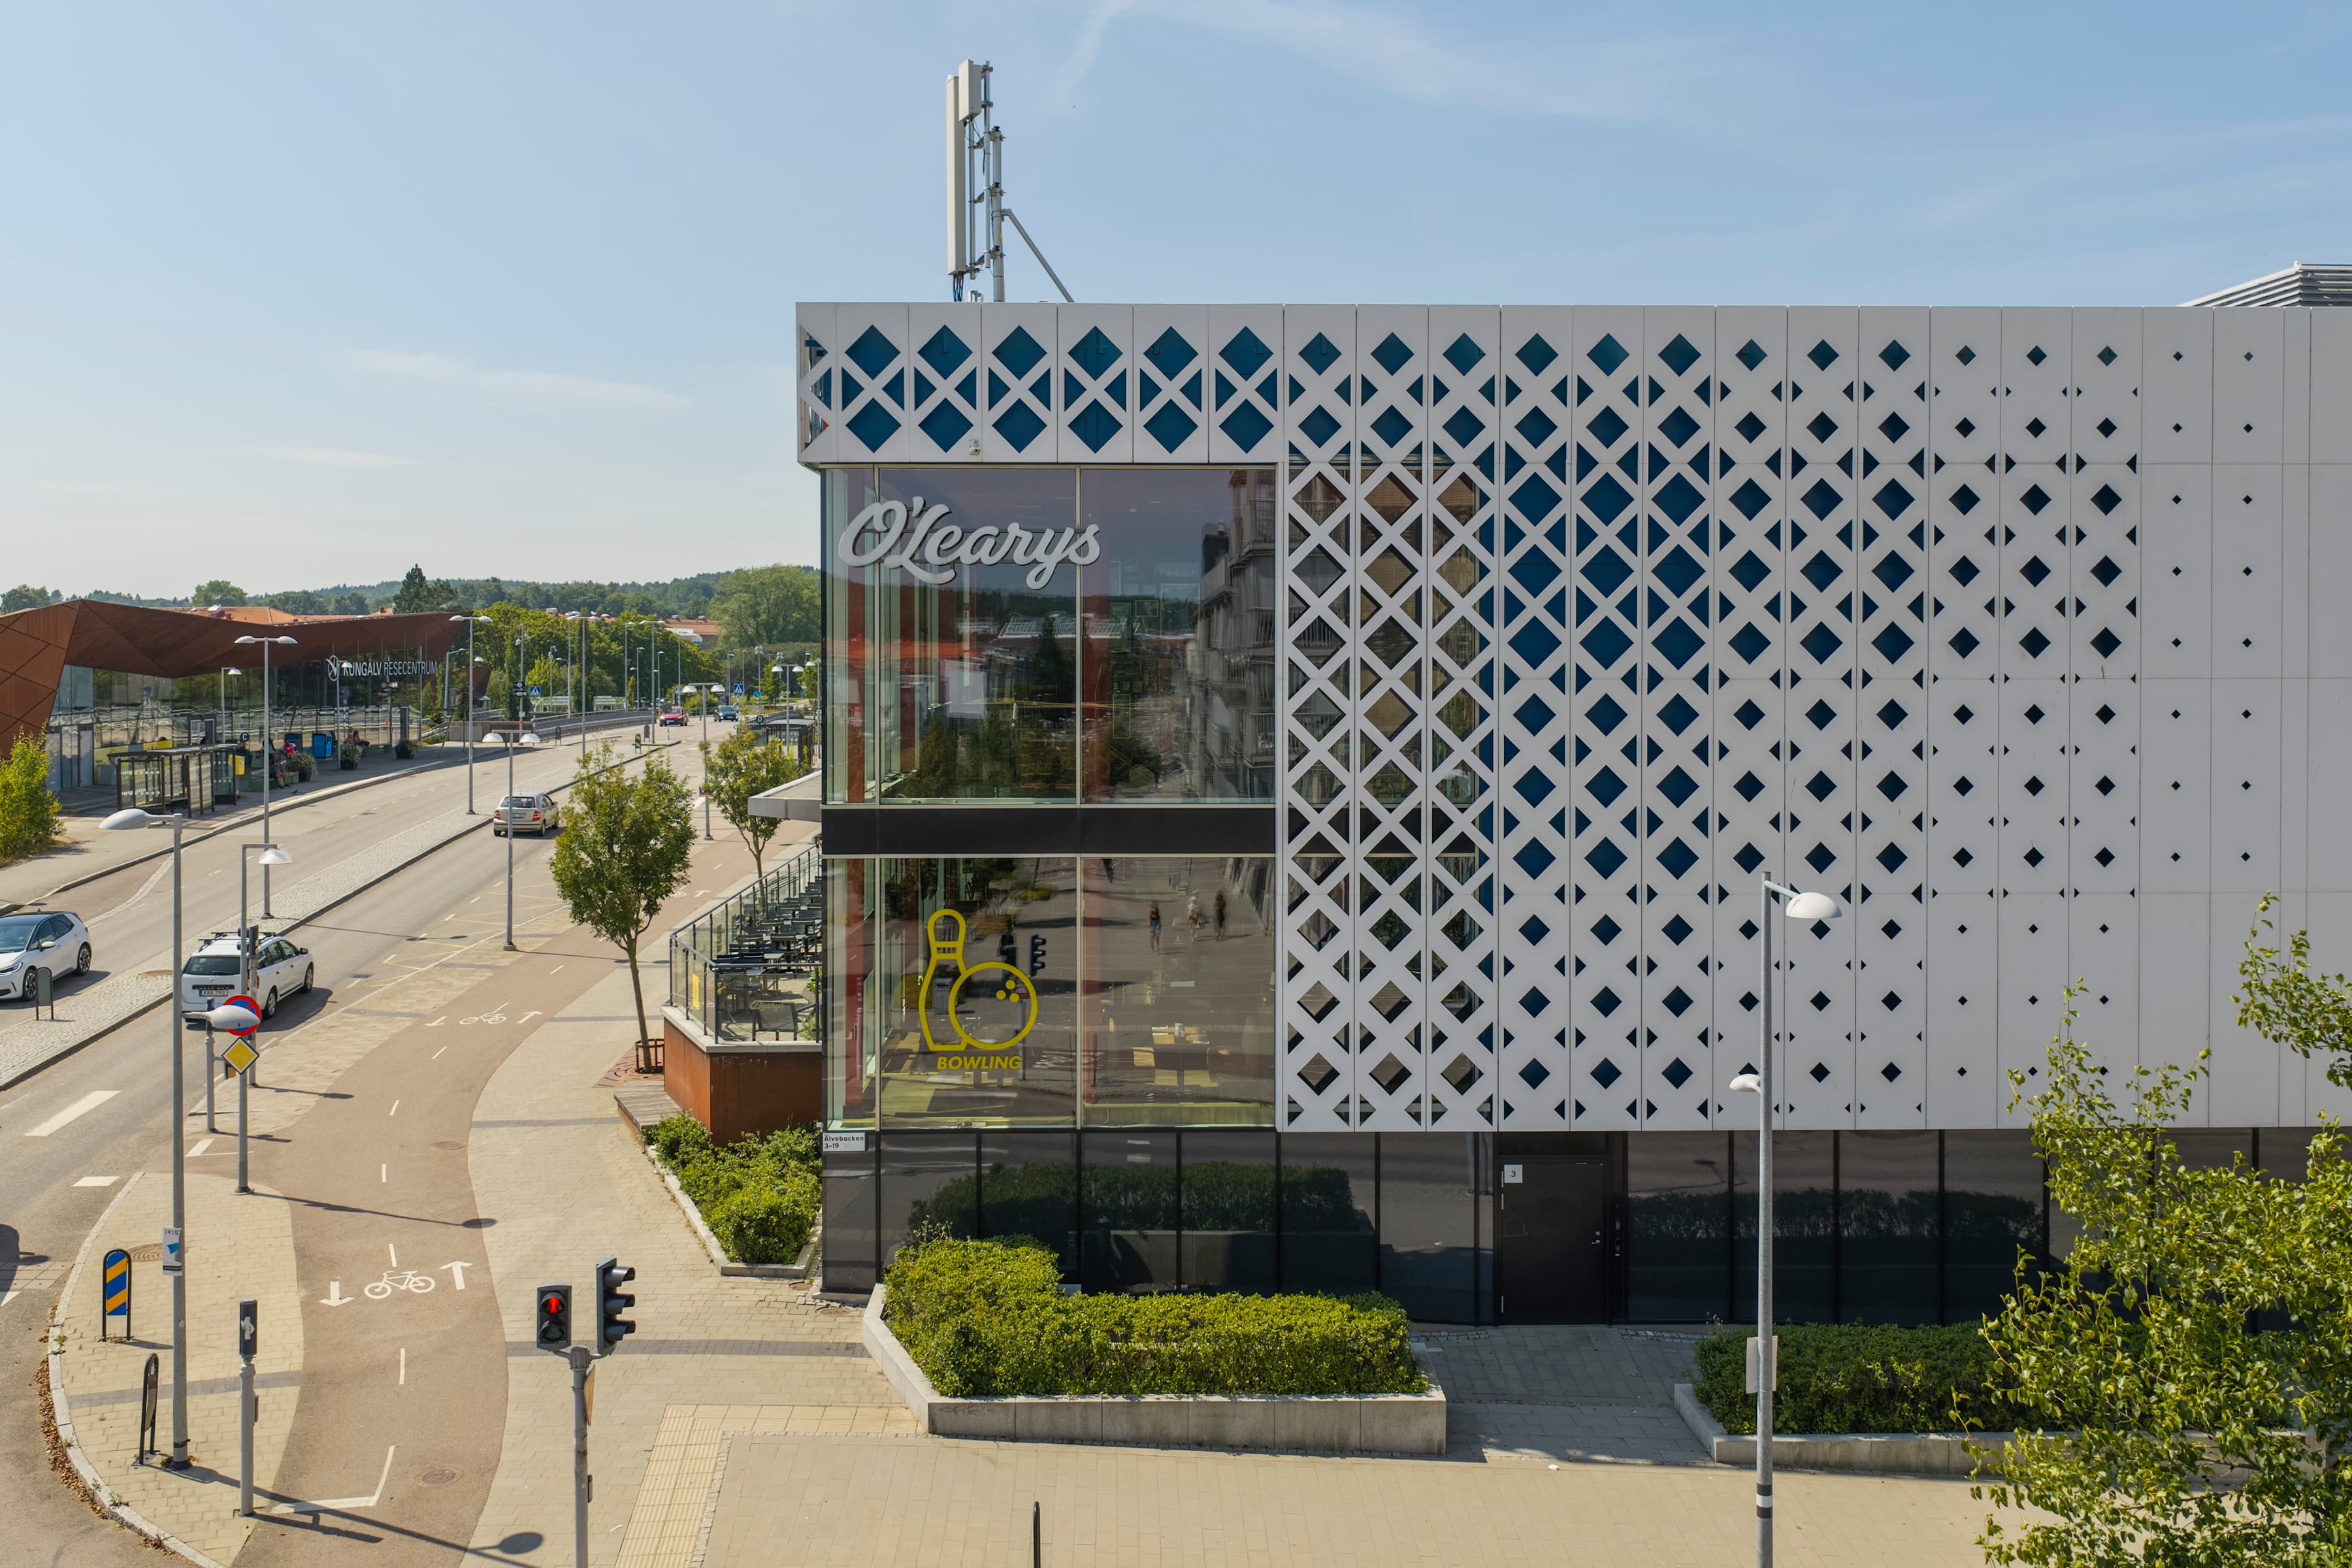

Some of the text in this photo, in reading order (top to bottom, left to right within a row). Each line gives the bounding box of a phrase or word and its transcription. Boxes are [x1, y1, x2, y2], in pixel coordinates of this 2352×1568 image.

[838, 497, 1100, 589] O'Learys
[384, 661, 437, 675] RESECENTRUM
[937, 1055, 1022, 1070] BOWLING
